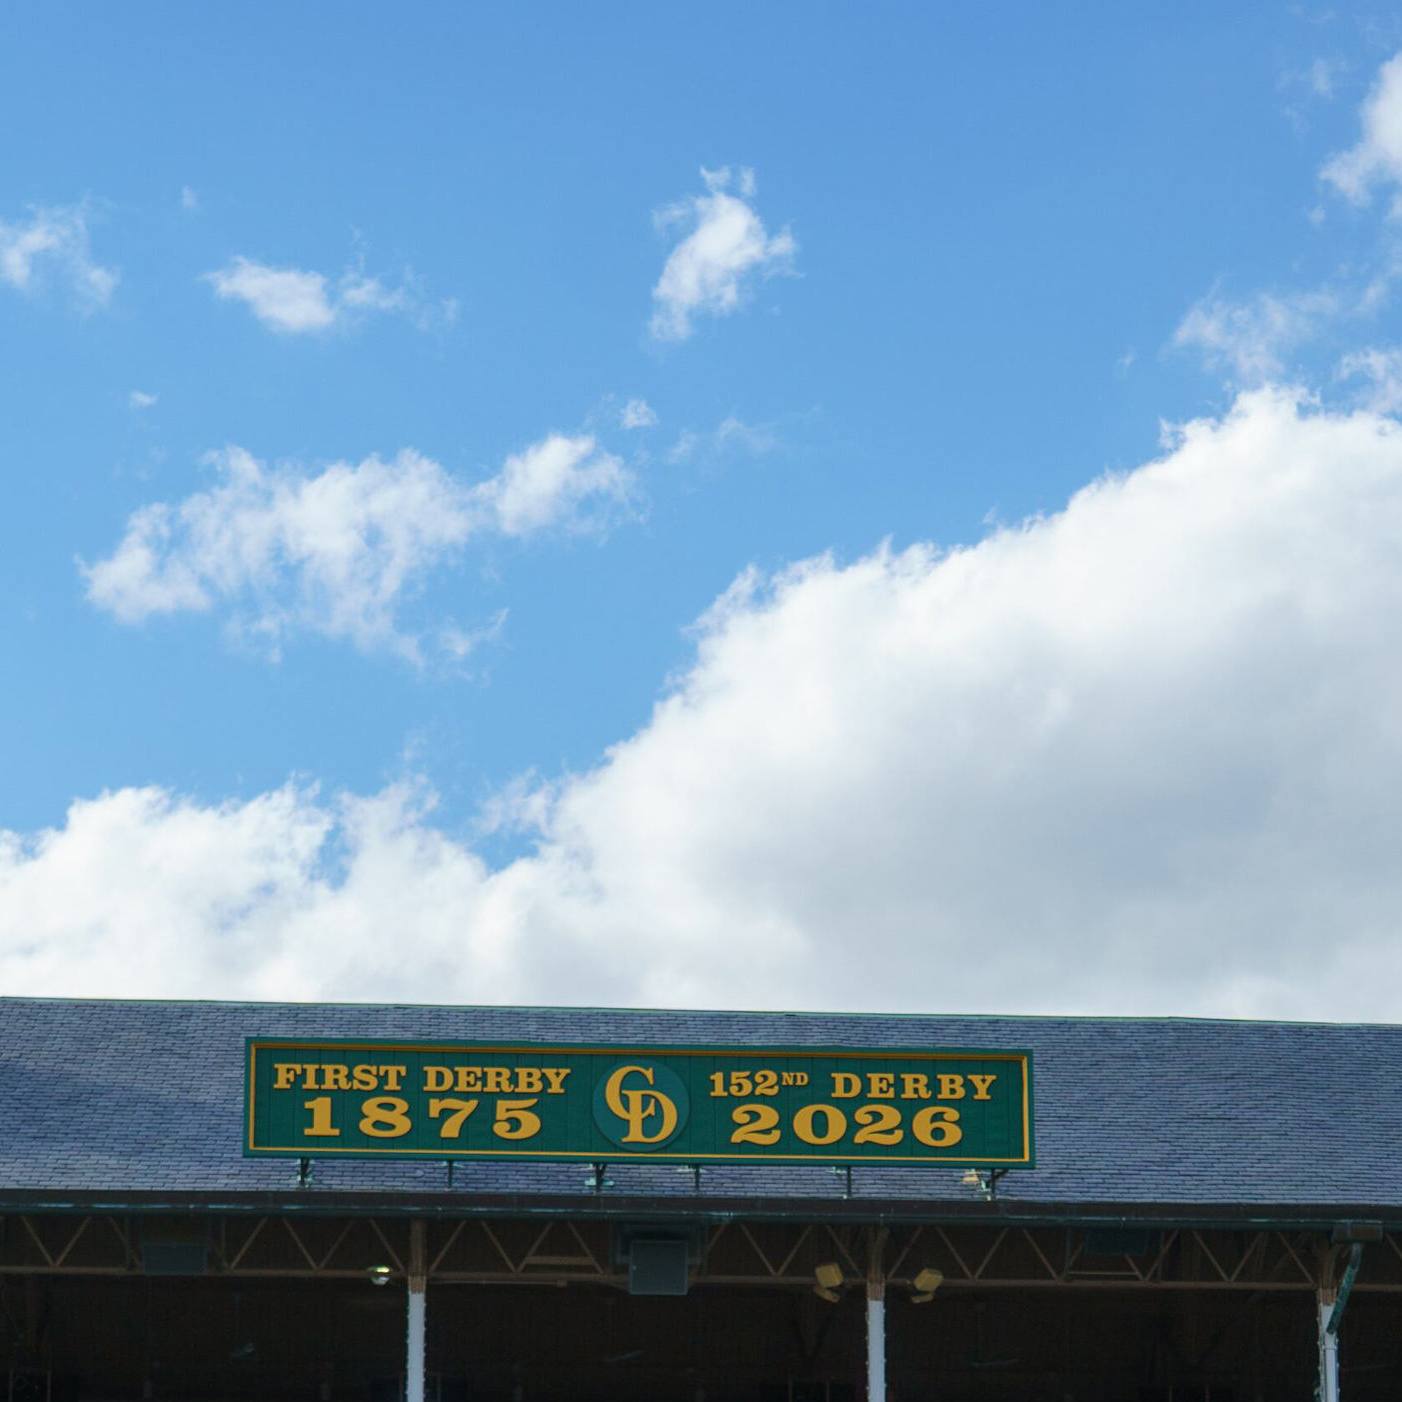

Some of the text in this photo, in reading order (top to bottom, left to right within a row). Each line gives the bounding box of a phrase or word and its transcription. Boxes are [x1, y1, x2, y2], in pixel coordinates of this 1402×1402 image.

[273, 1063, 571, 1094] FIRST DERBY
[710, 1070, 997, 1100] 152ND DERBY
[303, 1096, 542, 1140] 1875
[730, 1104, 963, 1148] 2026
